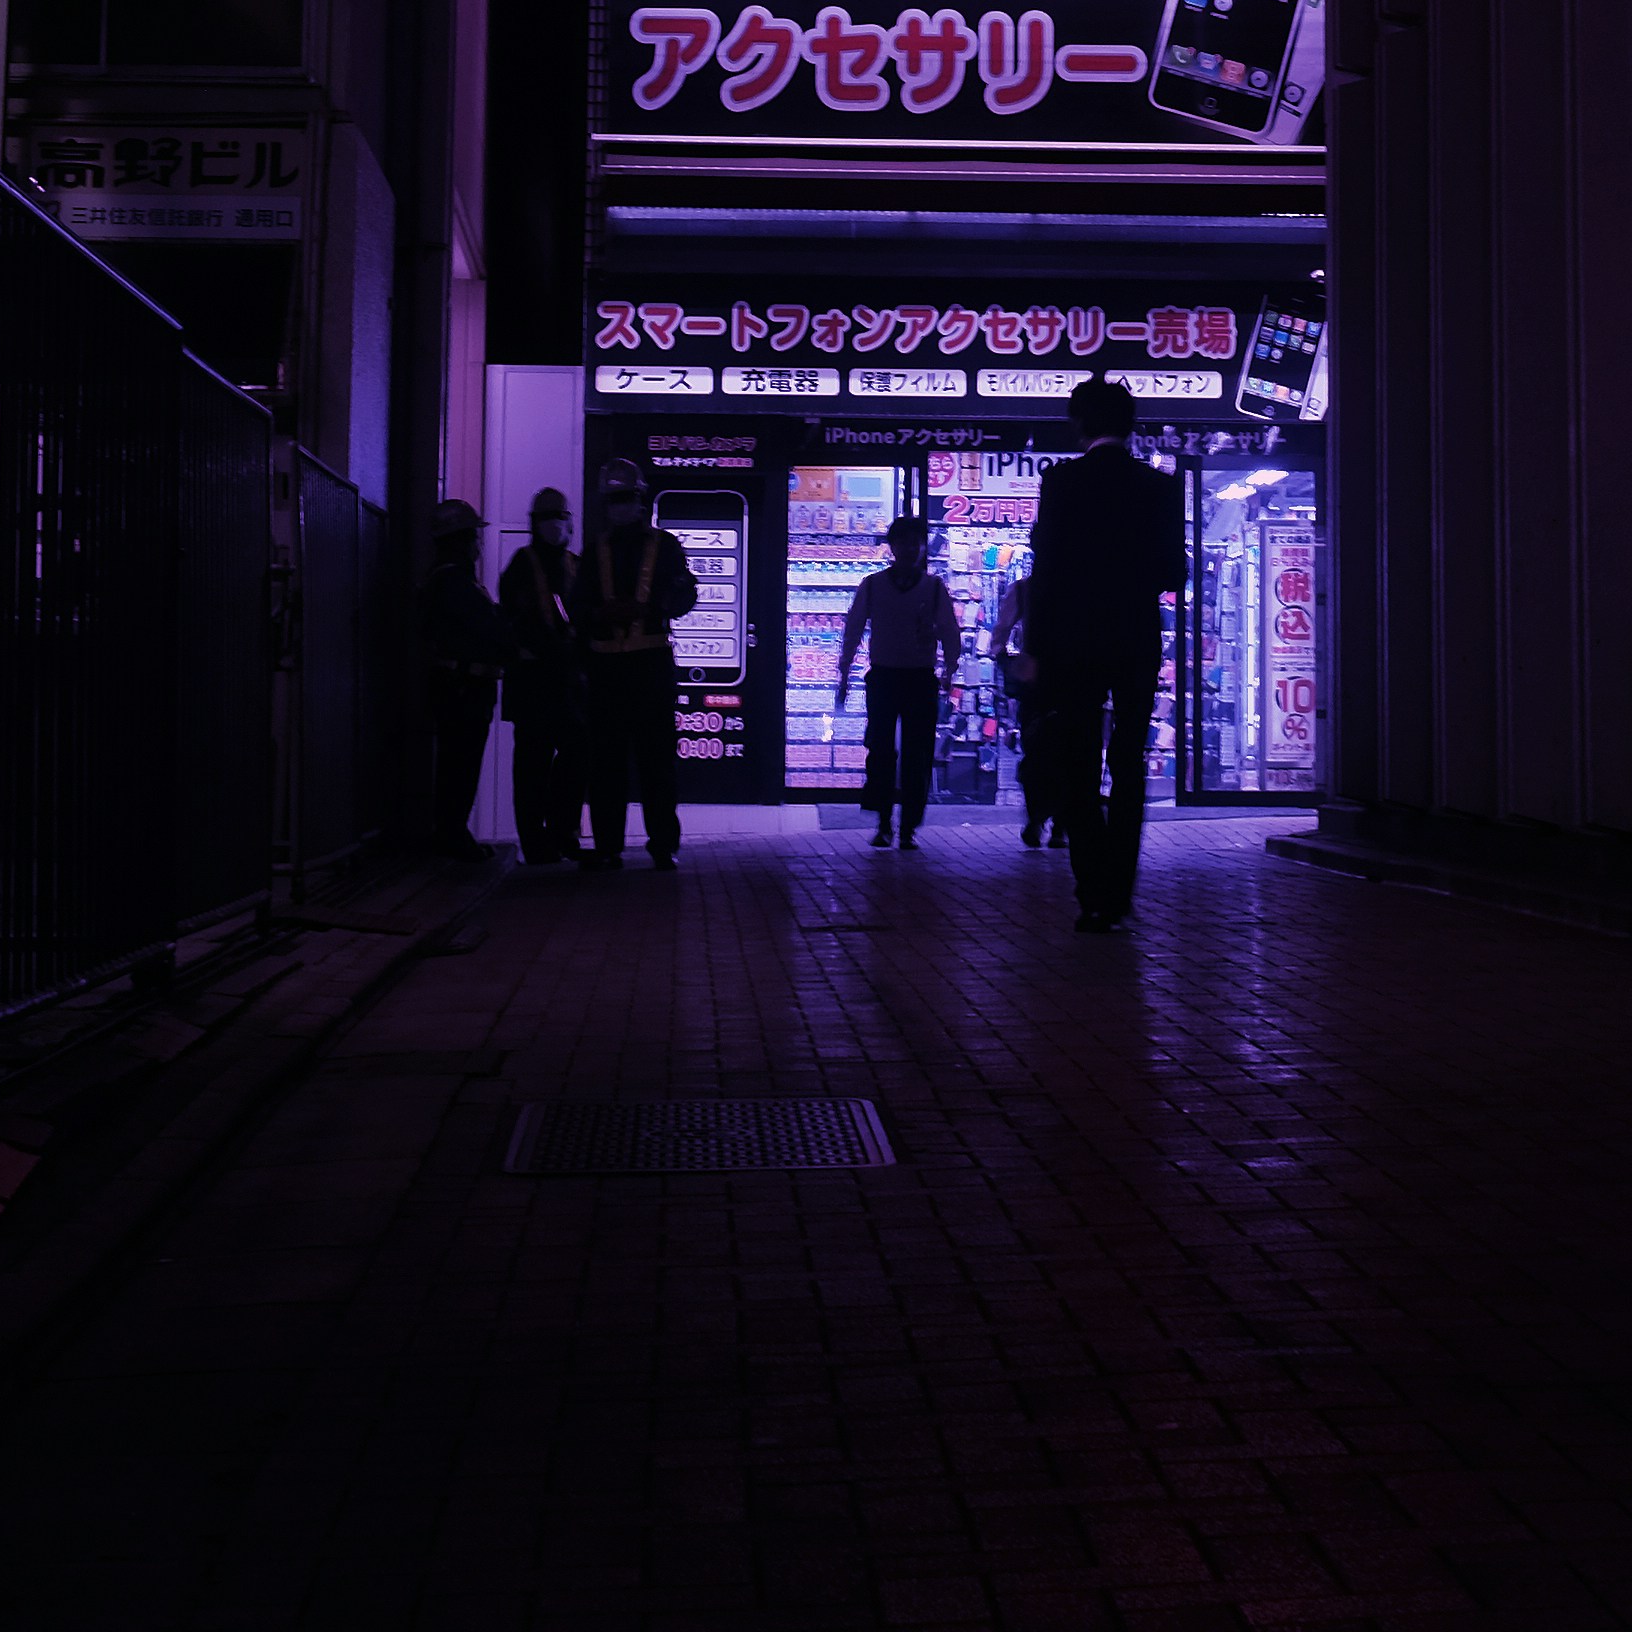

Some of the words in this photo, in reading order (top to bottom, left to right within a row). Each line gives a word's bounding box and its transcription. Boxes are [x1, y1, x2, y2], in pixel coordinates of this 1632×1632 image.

[630, 5, 1147, 115] アクセサリー
[35, 137, 300, 189] 高野ビル
[71, 205, 224, 228] 三井住友信託銀行
[234, 208, 293, 229] 通用口
[596, 301, 1238, 361] スマートフォンアクセサリー売場
[614, 367, 693, 390] ケース
[740, 368, 820, 393] 充電器
[858, 370, 958, 394] 保護フィルム
[686, 558, 725, 574] 電器
